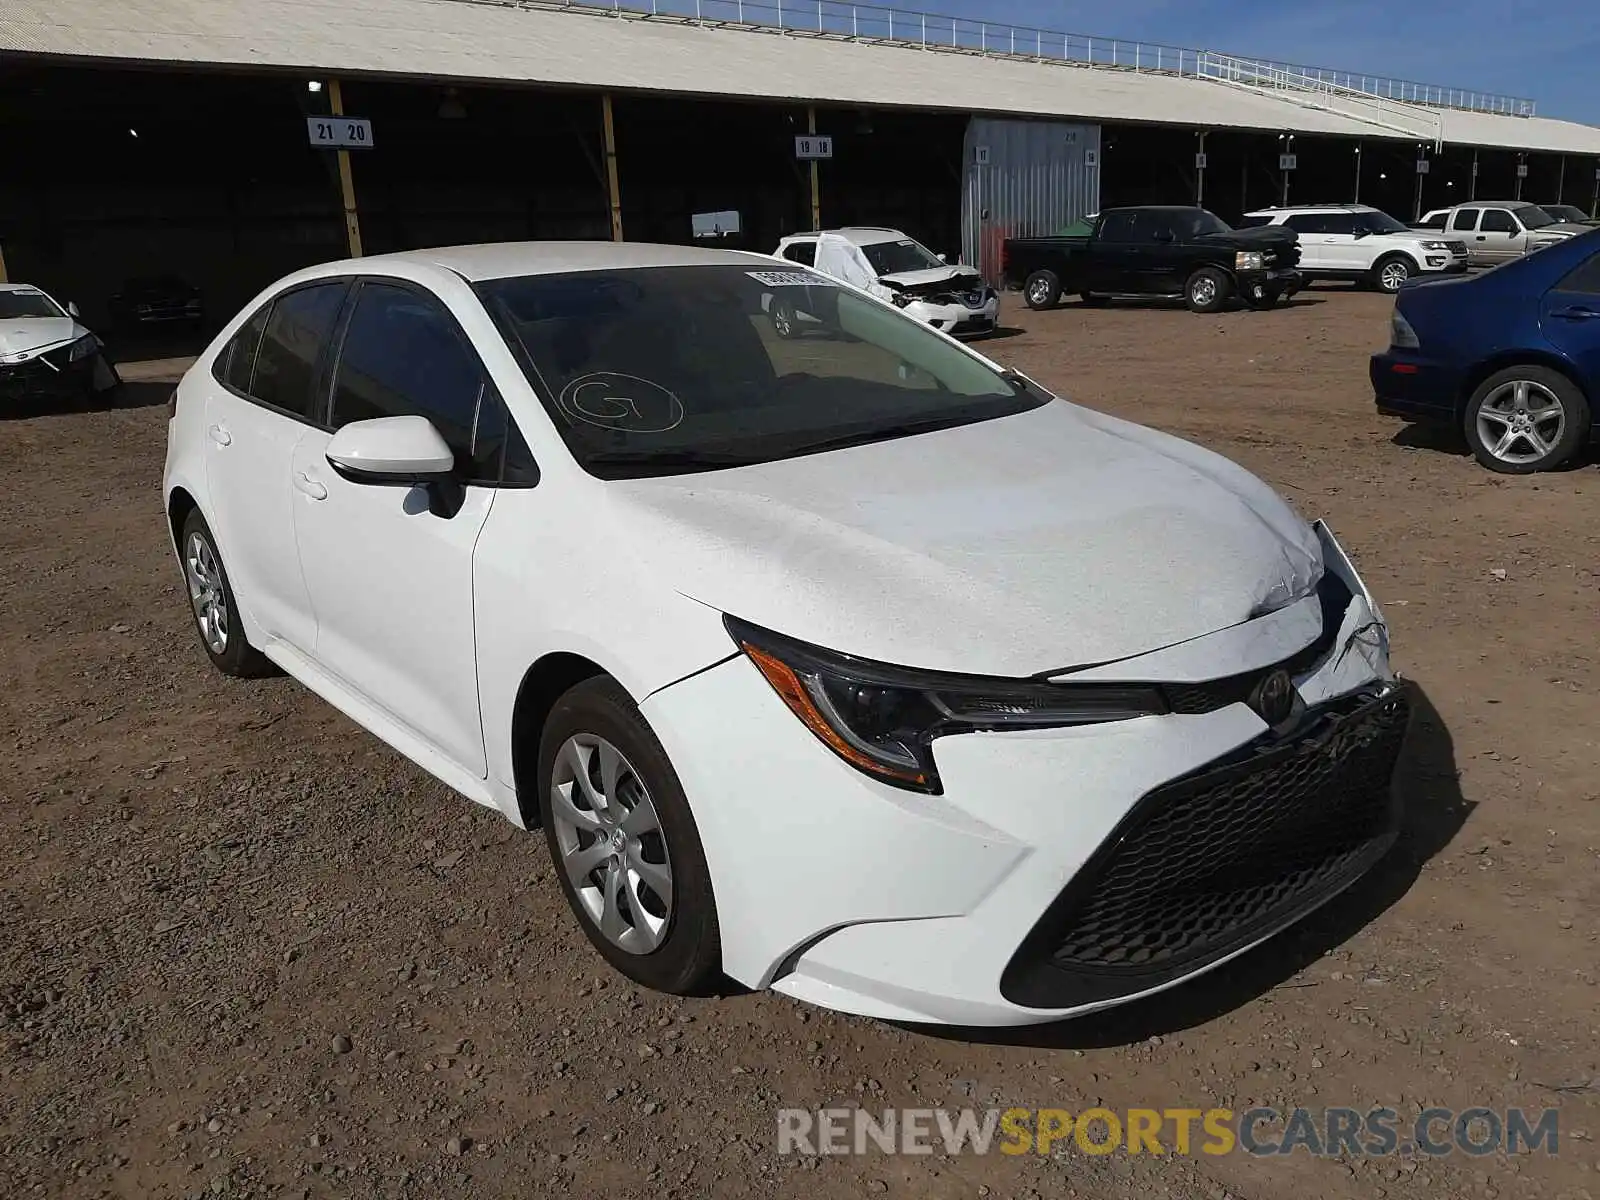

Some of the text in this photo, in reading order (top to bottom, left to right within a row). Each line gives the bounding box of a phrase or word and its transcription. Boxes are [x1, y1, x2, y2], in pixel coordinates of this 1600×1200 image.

[317, 123, 365, 141] 21 20
[573, 382, 643, 419] G
